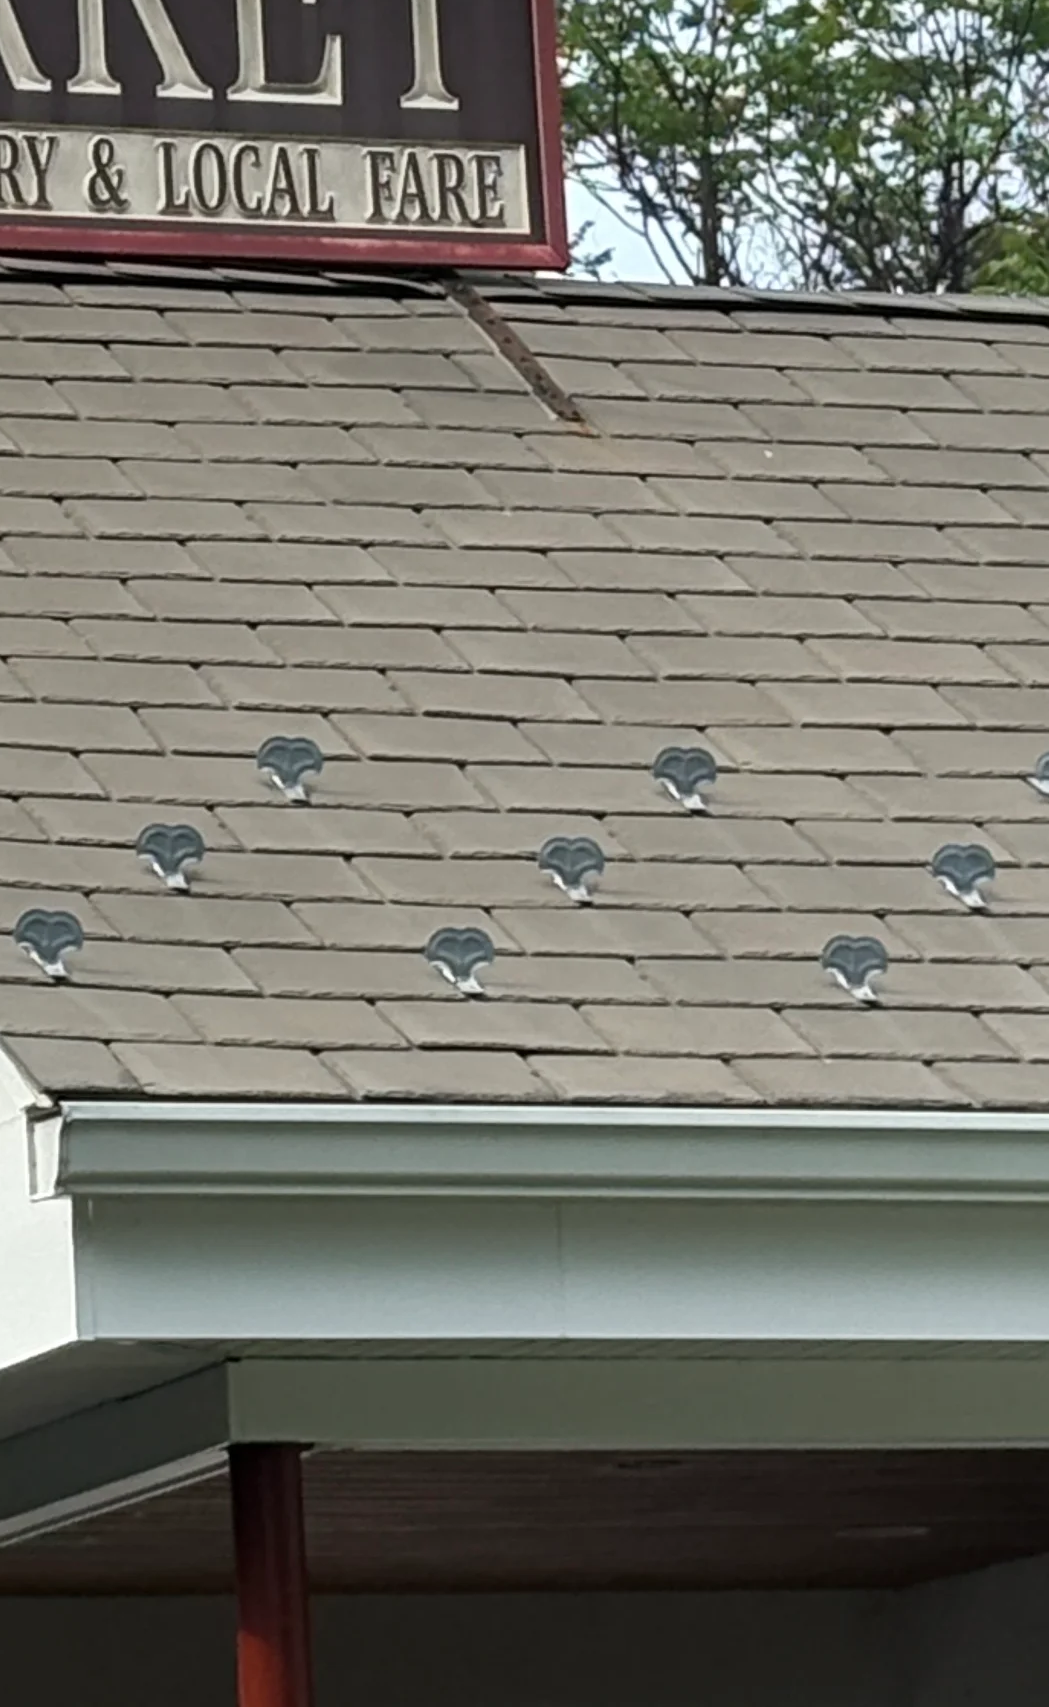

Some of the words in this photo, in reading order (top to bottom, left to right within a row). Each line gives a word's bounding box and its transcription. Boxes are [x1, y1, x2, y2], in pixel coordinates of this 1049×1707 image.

[86, 139, 129, 211] &
[157, 143, 334, 221] LOCAL
[364, 150, 505, 225] FARE
